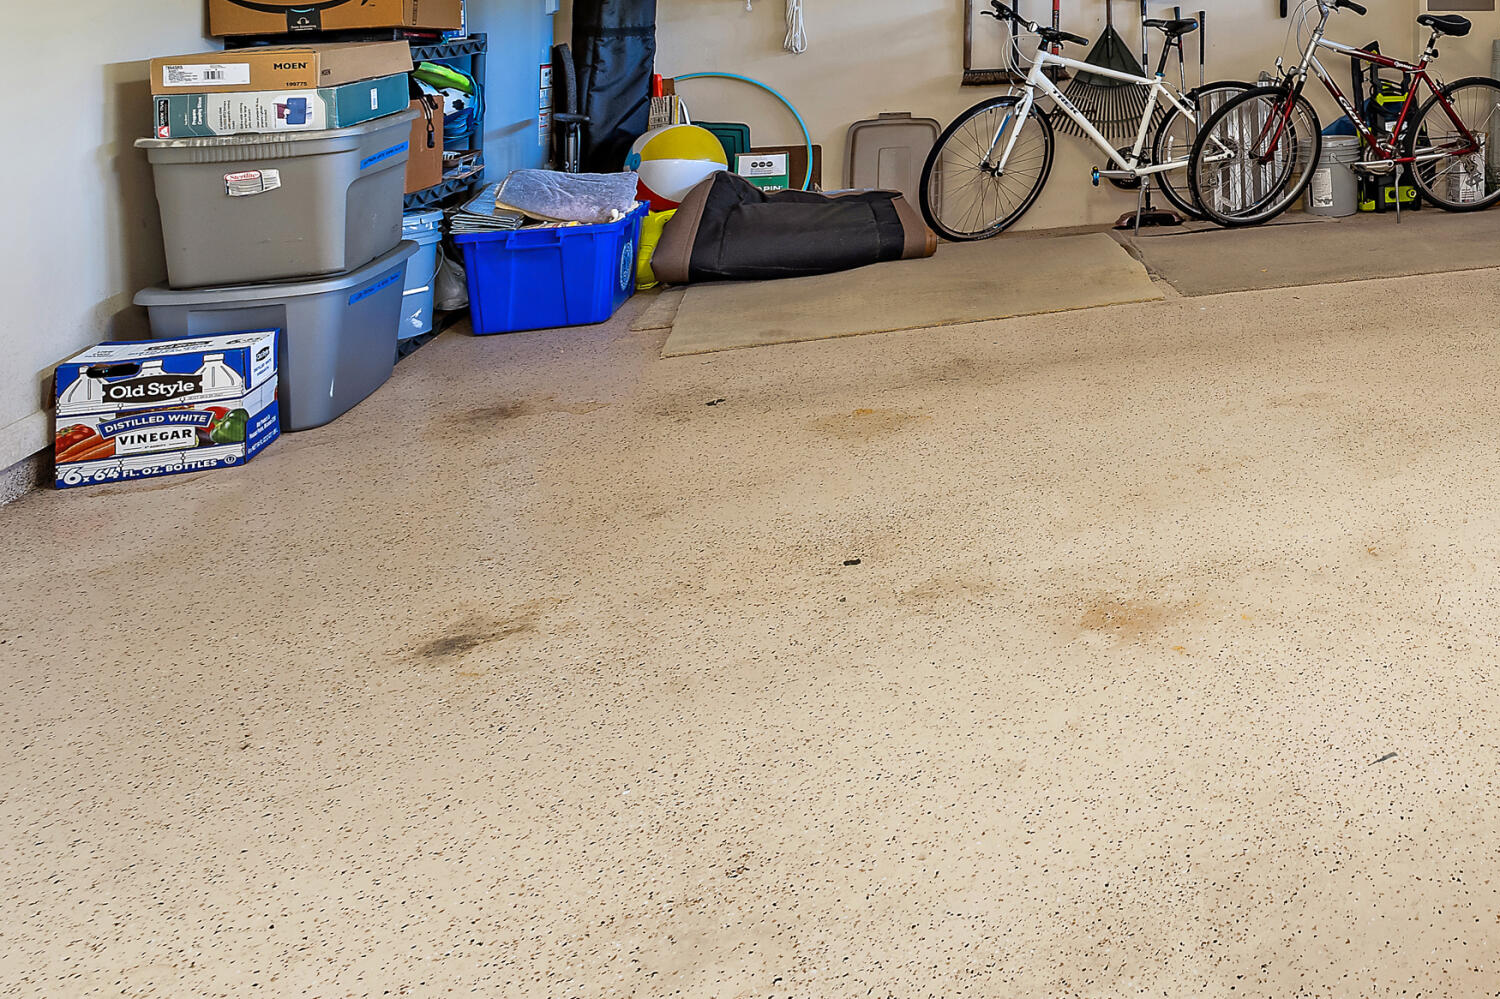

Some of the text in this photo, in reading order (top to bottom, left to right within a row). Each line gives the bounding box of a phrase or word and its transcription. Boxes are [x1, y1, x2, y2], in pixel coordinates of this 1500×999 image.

[273, 62, 307, 70] MOEN
[1053, 88, 1079, 115] TREK
[110, 385, 145, 399] Old
[147, 380, 195, 397] Style
[104, 414, 208, 433] DISTILLED WHITE
[118, 429, 192, 446] VINEGAR
[63, 467, 83, 485] 6
[94, 468, 119, 481] 64
[122, 469, 140, 477] FL.
[142, 466, 163, 475] OZ.
[165, 459, 218, 472] BOTTLES
